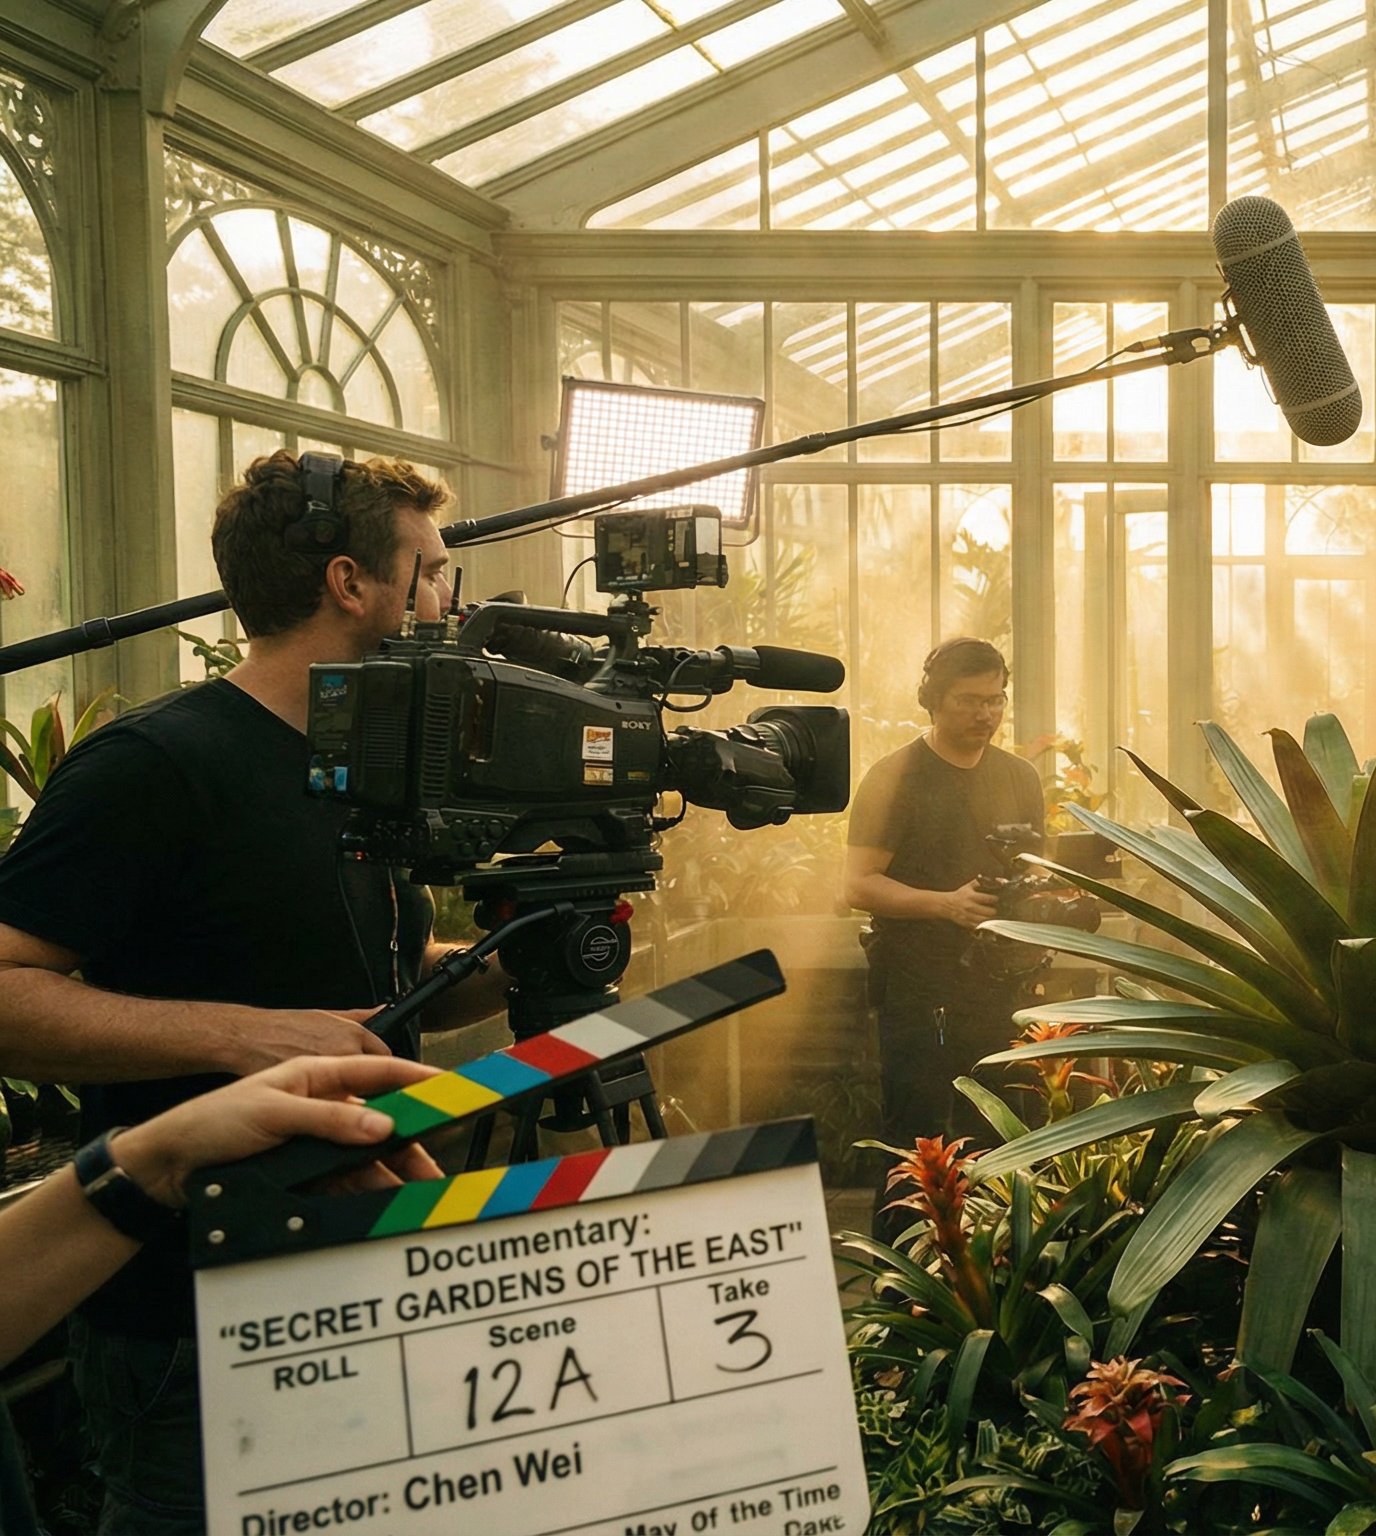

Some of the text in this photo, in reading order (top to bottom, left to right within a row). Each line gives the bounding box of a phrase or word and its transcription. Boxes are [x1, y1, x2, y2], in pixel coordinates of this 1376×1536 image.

[404, 1213, 651, 1278] Documentary:
[395, 1265, 566, 1323] GARDENS
[575, 1254, 620, 1289] OF
[629, 1239, 697, 1278] THE
[707, 1277, 771, 1305] Take
[488, 1315, 578, 1349] Scene
[713, 1308, 773, 1374] 3
[273, 1355, 359, 1392] ROLL
[241, 1441, 583, 1536] Director: Chen Wei
[729, 1499, 773, 1524] the
[777, 1483, 841, 1512] Time
